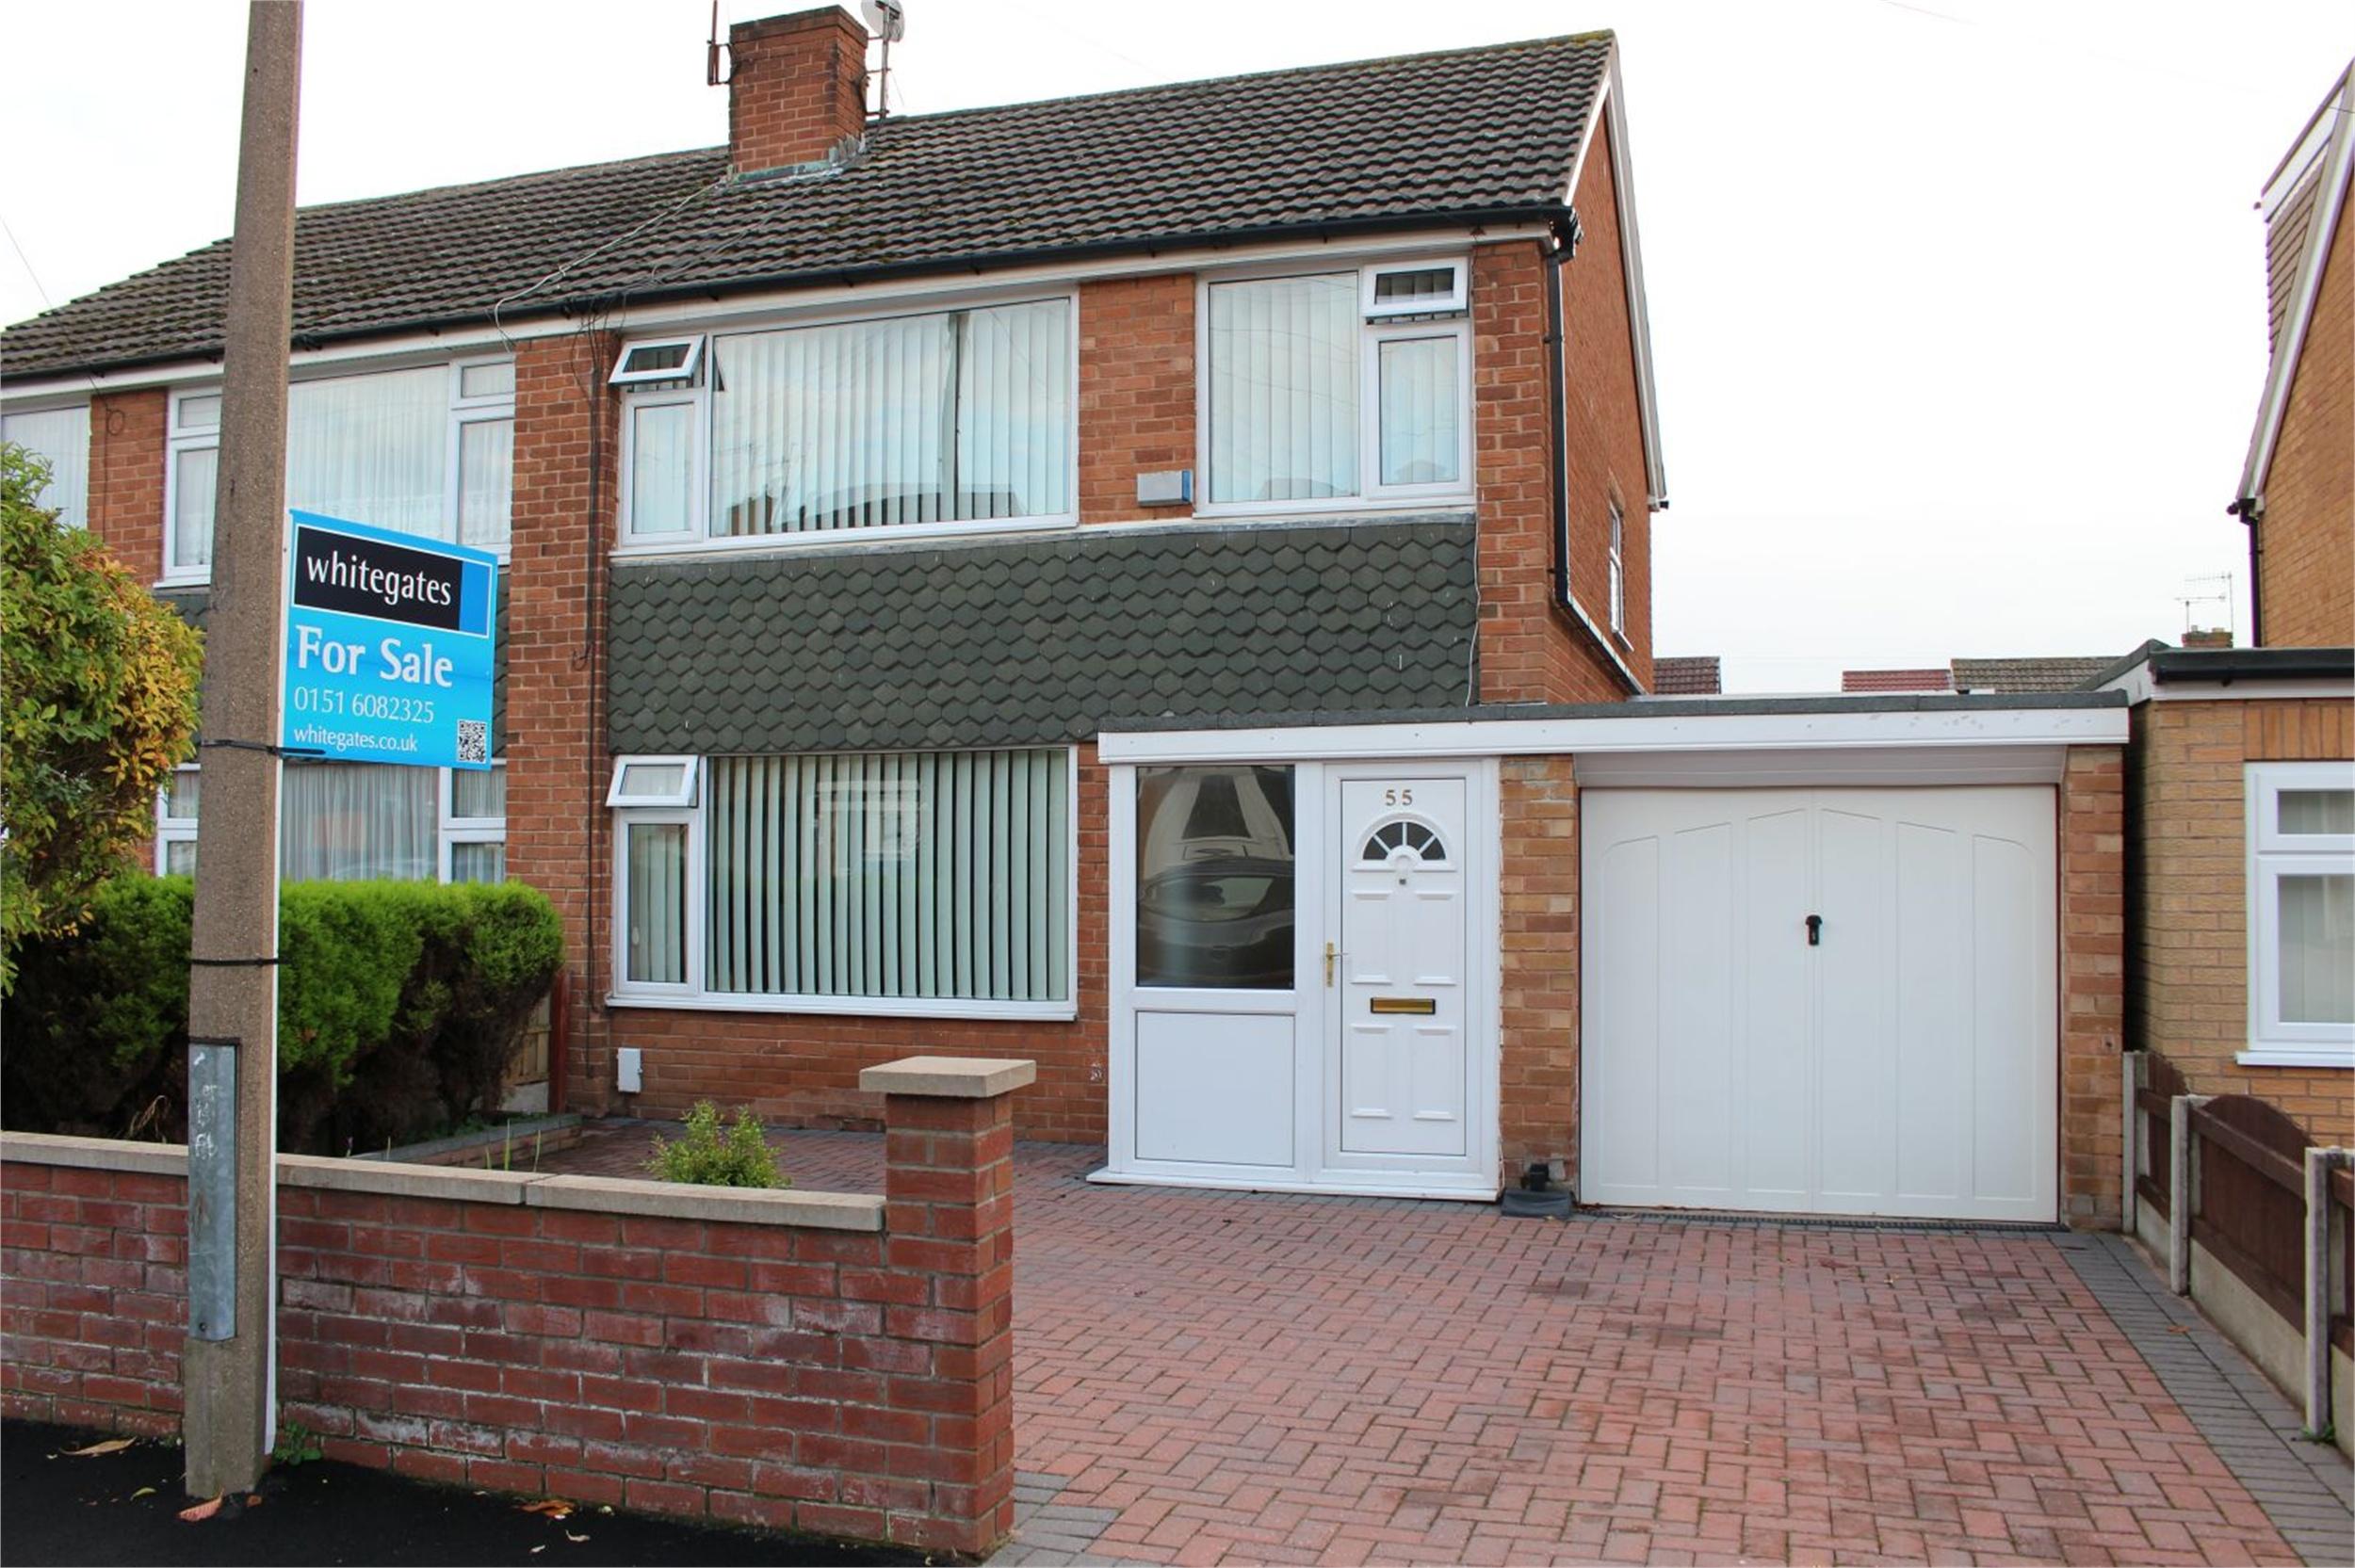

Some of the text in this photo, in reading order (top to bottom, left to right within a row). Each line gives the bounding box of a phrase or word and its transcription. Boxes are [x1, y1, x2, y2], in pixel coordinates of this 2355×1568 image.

[307, 550, 451, 606] whitegates
[295, 624, 453, 687] For Sale
[294, 686, 434, 723] 0151 6082325
[294, 723, 417, 752] whitegates.co.uk
[1385, 789, 1413, 806] 55
